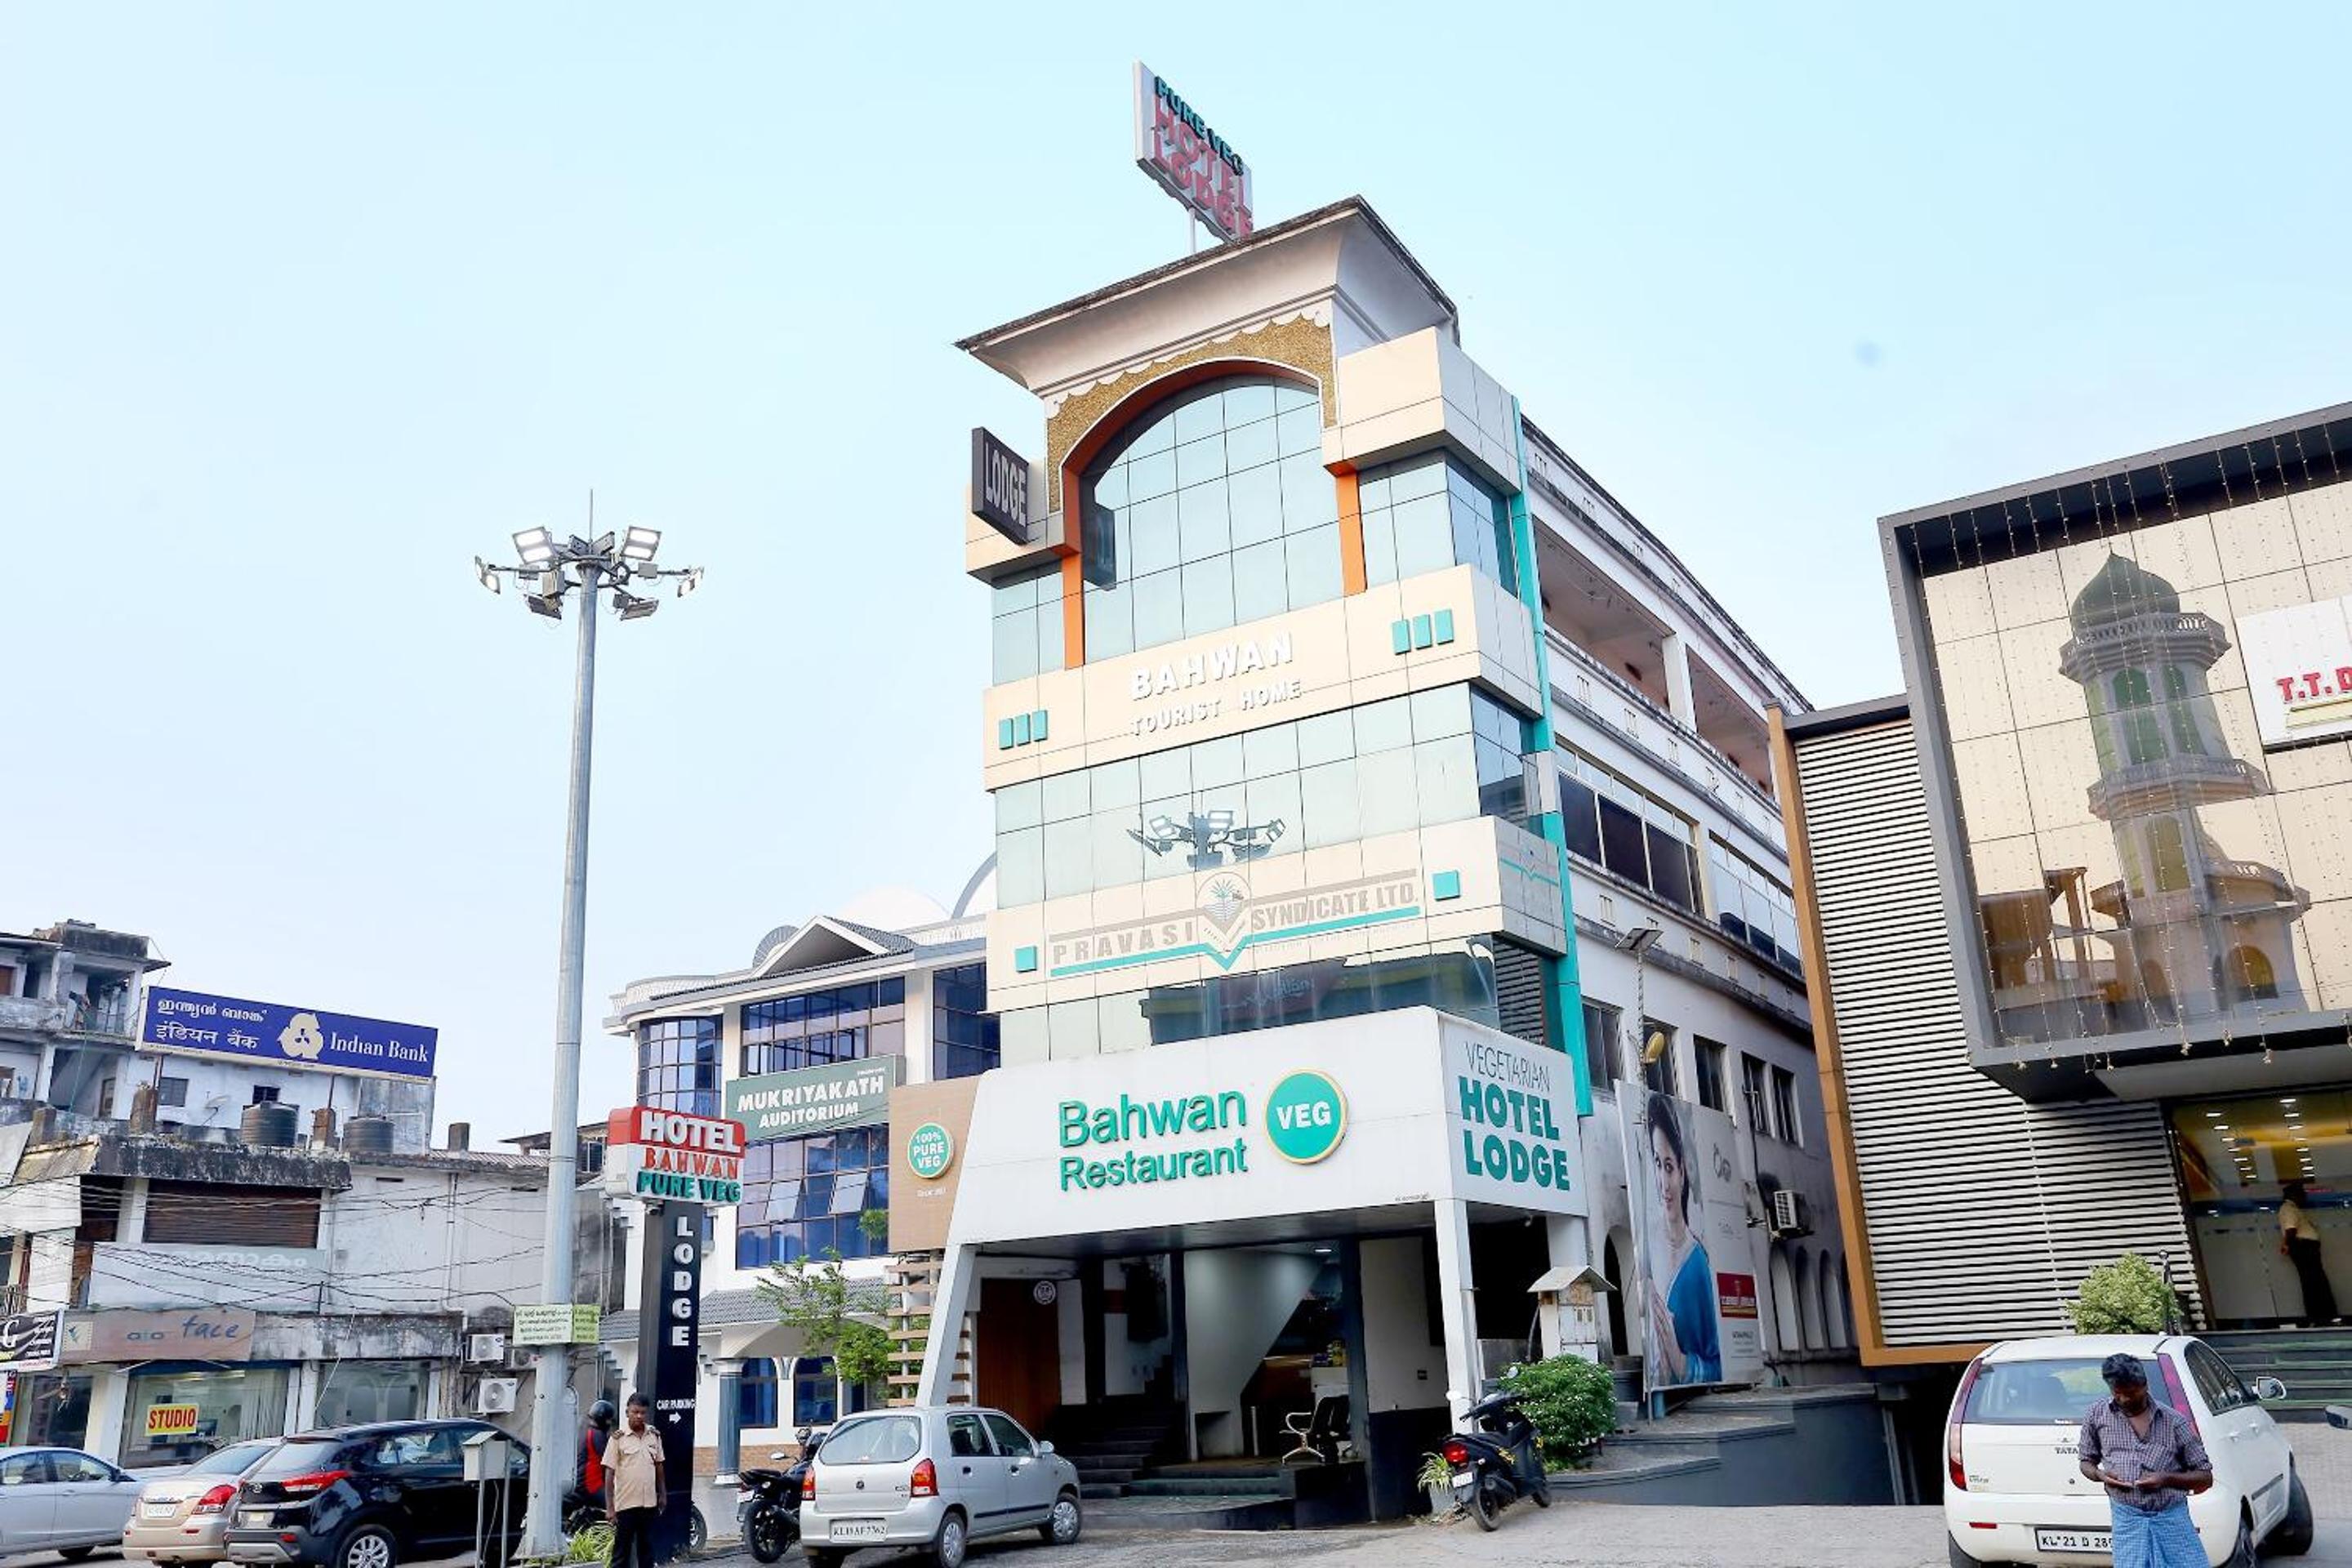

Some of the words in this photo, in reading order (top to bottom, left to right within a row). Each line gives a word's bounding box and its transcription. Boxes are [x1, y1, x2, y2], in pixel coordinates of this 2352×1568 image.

[1155, 76, 1205, 140] PURE
[1207, 127, 1244, 176] VEG
[985, 442, 1027, 528] LODGE
[1130, 630, 1293, 701] BAHWAN
[1130, 700, 1221, 736] TOURIST
[1242, 679, 1302, 710] HOME
[1253, 890, 1370, 930] SYNDICATE
[1375, 883, 1418, 908] LTD.
[1054, 921, 1193, 964] PRAVASI
[157, 1021, 218, 1045] इंडियन
[330, 1031, 383, 1056] Indian
[389, 1040, 428, 1062] Bank
[1466, 1040, 1551, 1093] VEGETARIAN
[737, 1076, 884, 1112] MUKRIYAKATH
[759, 1102, 858, 1129] AUDITORIUM
[1458, 1076, 1560, 1141] HOTEL
[640, 1110, 742, 1153] HOTEL
[915, 1131, 942, 1144] 100%
[1059, 1089, 1248, 1147] Bahwan
[1276, 1102, 1332, 1130] VEG
[644, 1147, 738, 1180] BAHWAN
[914, 1142, 945, 1157] PURE
[916, 1154, 941, 1169] VEG
[1060, 1138, 1249, 1192] Restaurant
[1463, 1129, 1570, 1192] LODGE
[637, 1170, 695, 1198] PURE
[698, 1178, 742, 1203] VEG
[671, 1216, 694, 1346] LODGE
[182, 1314, 239, 1340] face
[149, 1408, 196, 1428] STUDIO
